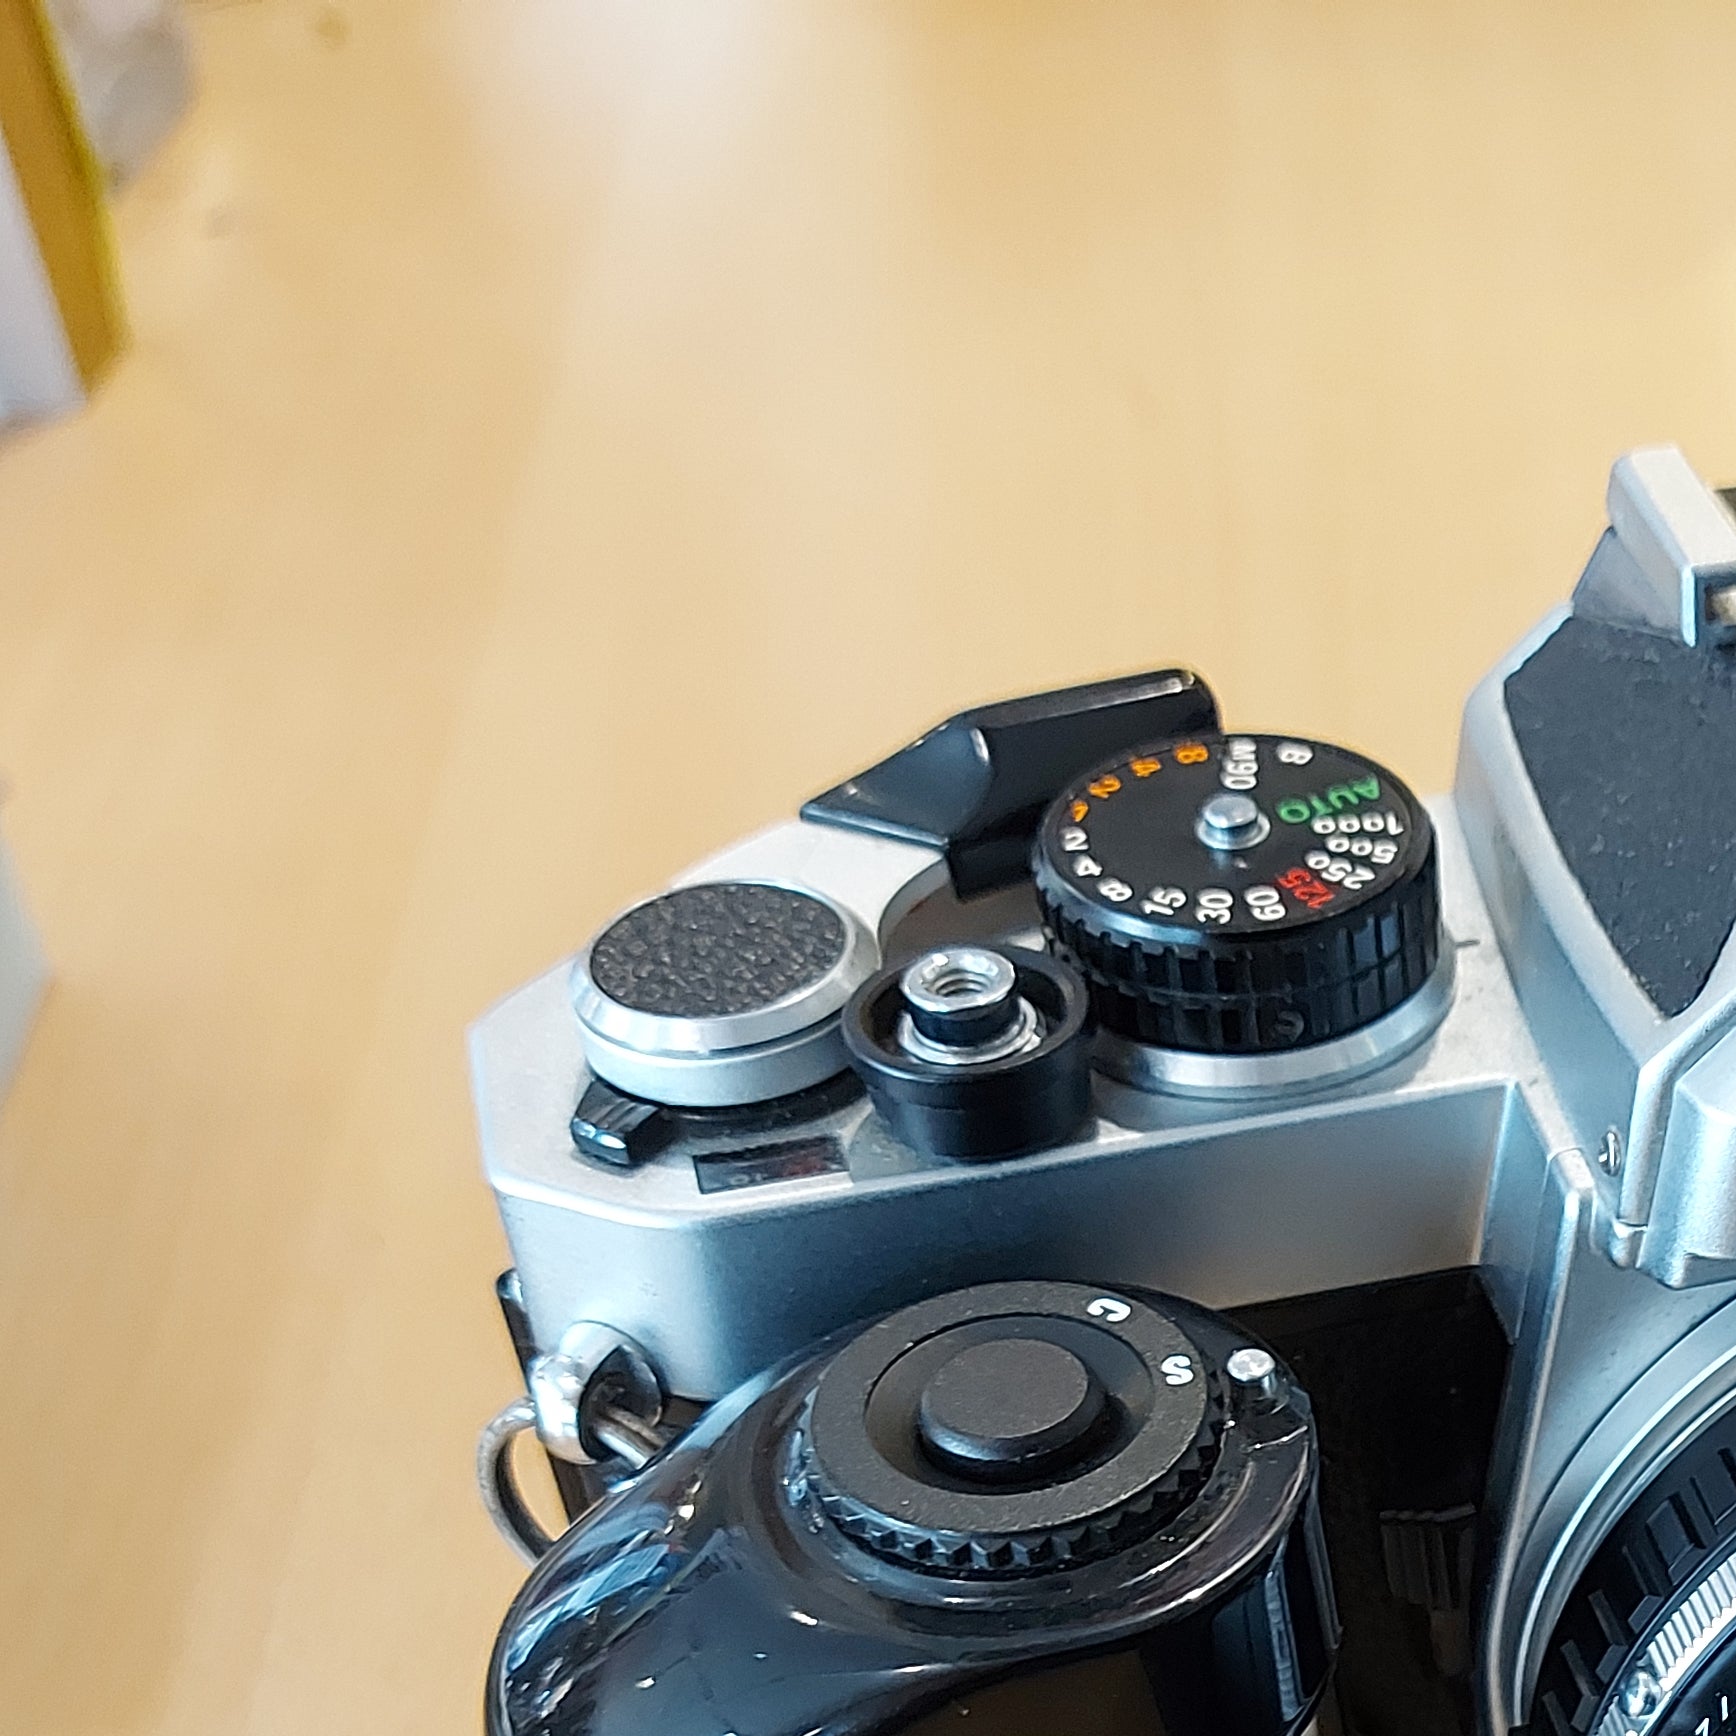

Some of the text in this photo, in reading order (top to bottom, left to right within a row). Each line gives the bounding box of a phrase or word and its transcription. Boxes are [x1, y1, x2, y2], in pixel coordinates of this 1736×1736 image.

[1175, 743, 1209, 764] 8
[1131, 758, 1161, 777] 4
[1088, 775, 1121, 798] 2
[1278, 773, 1381, 823] AUTO
[1312, 812, 1403, 835] 1000
[1062, 827, 1088, 852] 2
[1325, 834, 1399, 865] 500
[1074, 855, 1103, 877] 4
[1305, 850, 1375, 889] 250
[1098, 878, 1133, 902] 8
[1141, 886, 1186, 916] 15
[1276, 868, 1335, 909] 125
[1196, 889, 1233, 925] 30
[1244, 886, 1286, 921] 60
[1087, 1297, 1131, 1322] C
[1161, 1354, 1194, 1385] S
